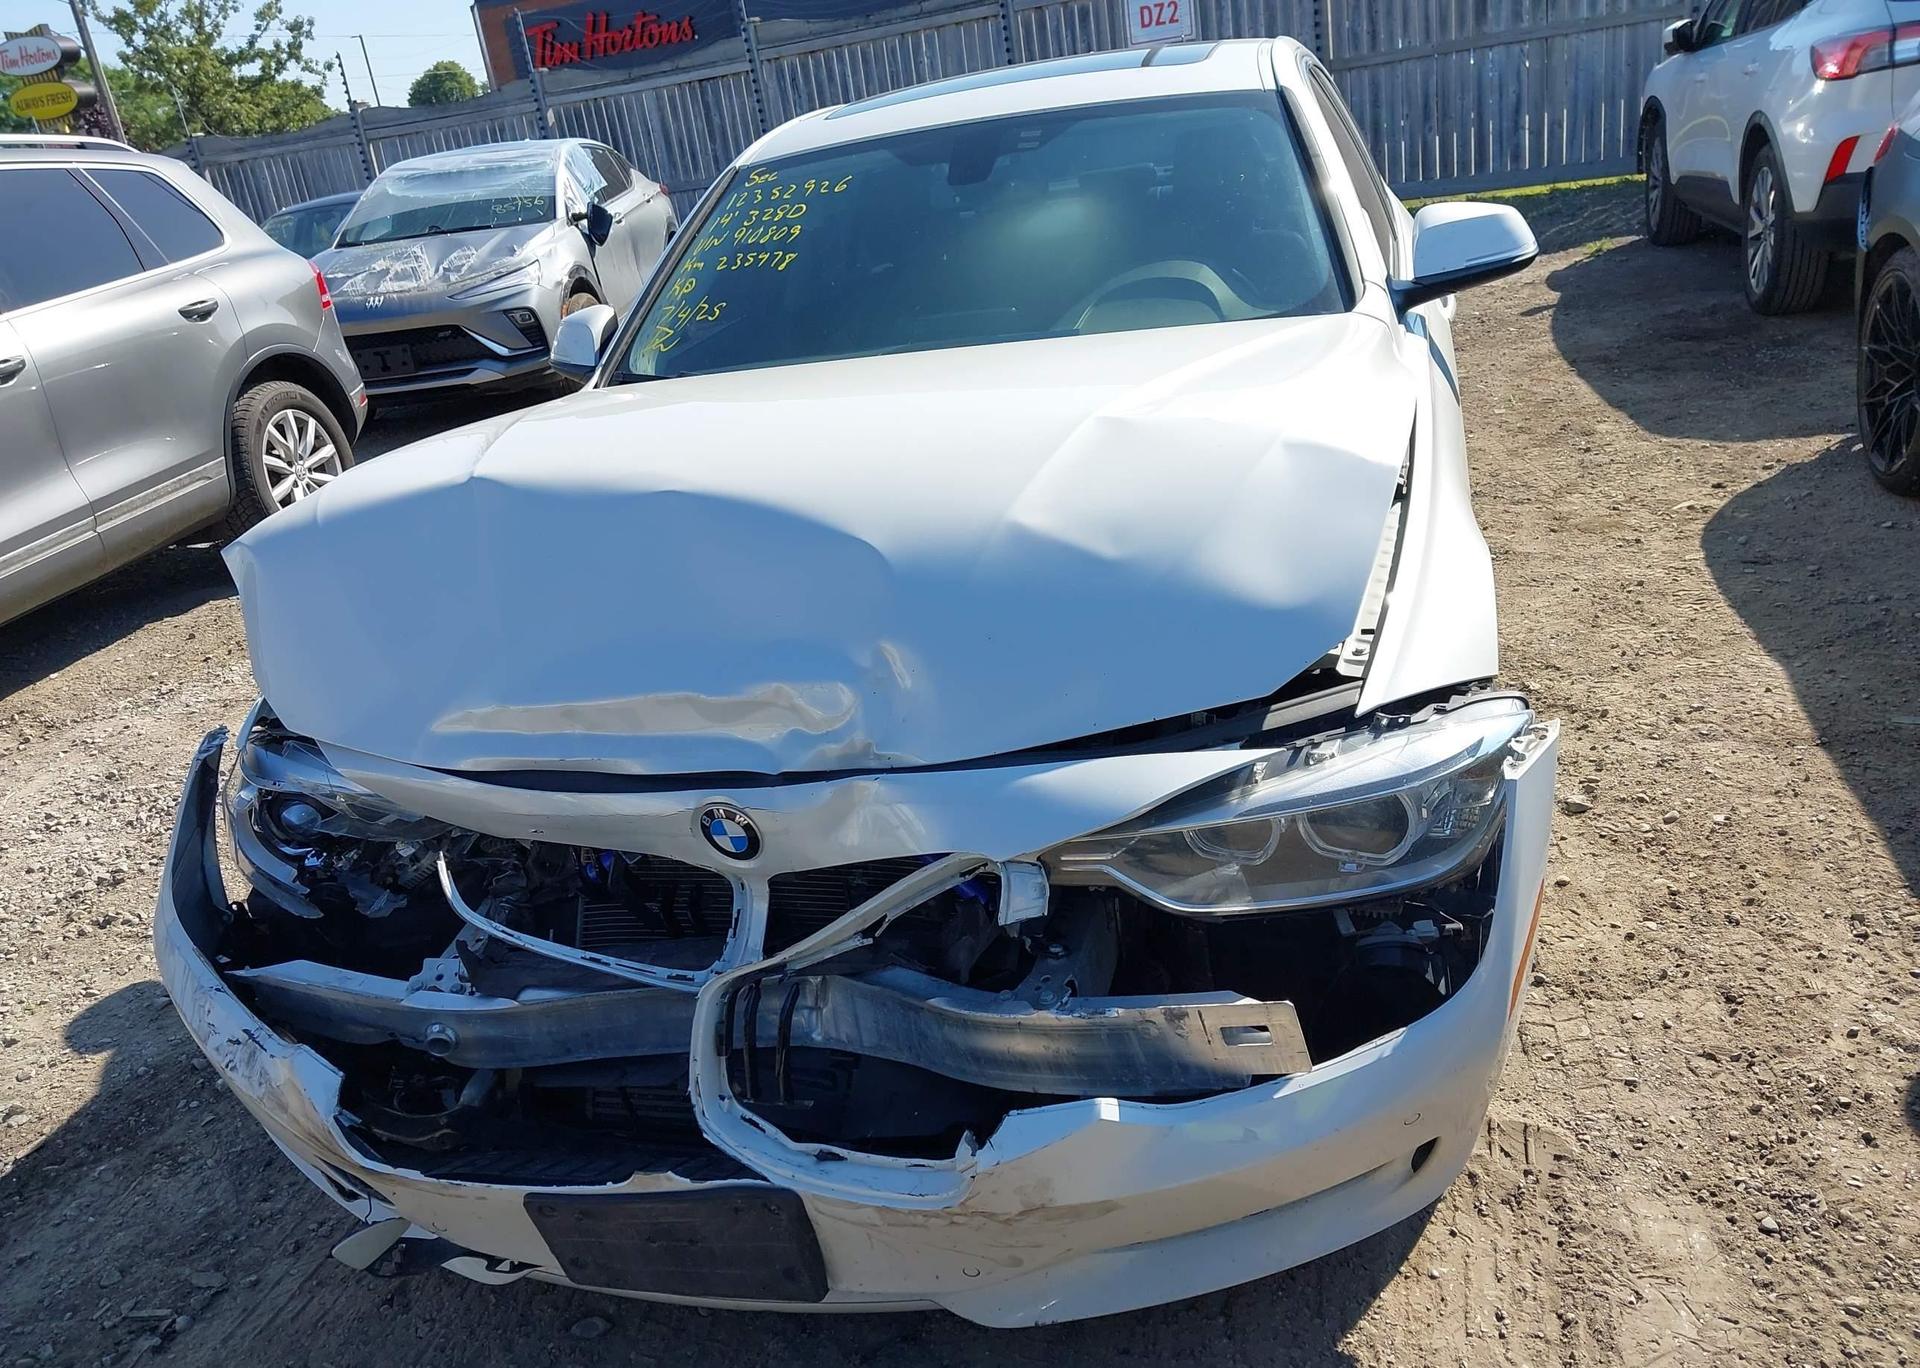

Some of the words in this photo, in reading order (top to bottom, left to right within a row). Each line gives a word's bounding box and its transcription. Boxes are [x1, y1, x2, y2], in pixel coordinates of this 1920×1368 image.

[1140, 1, 1180, 28] DZ2
[527, 22, 580, 69] Tim
[585, 11, 694, 58] Hortons
[0, 49, 19, 71] Tim
[16, 95, 45, 112] ALAYS
[46, 90, 72, 106] FRESH
[744, 204, 806, 226] 328D
[734, 225, 801, 247] 910809
[702, 808, 748, 827] BMW
